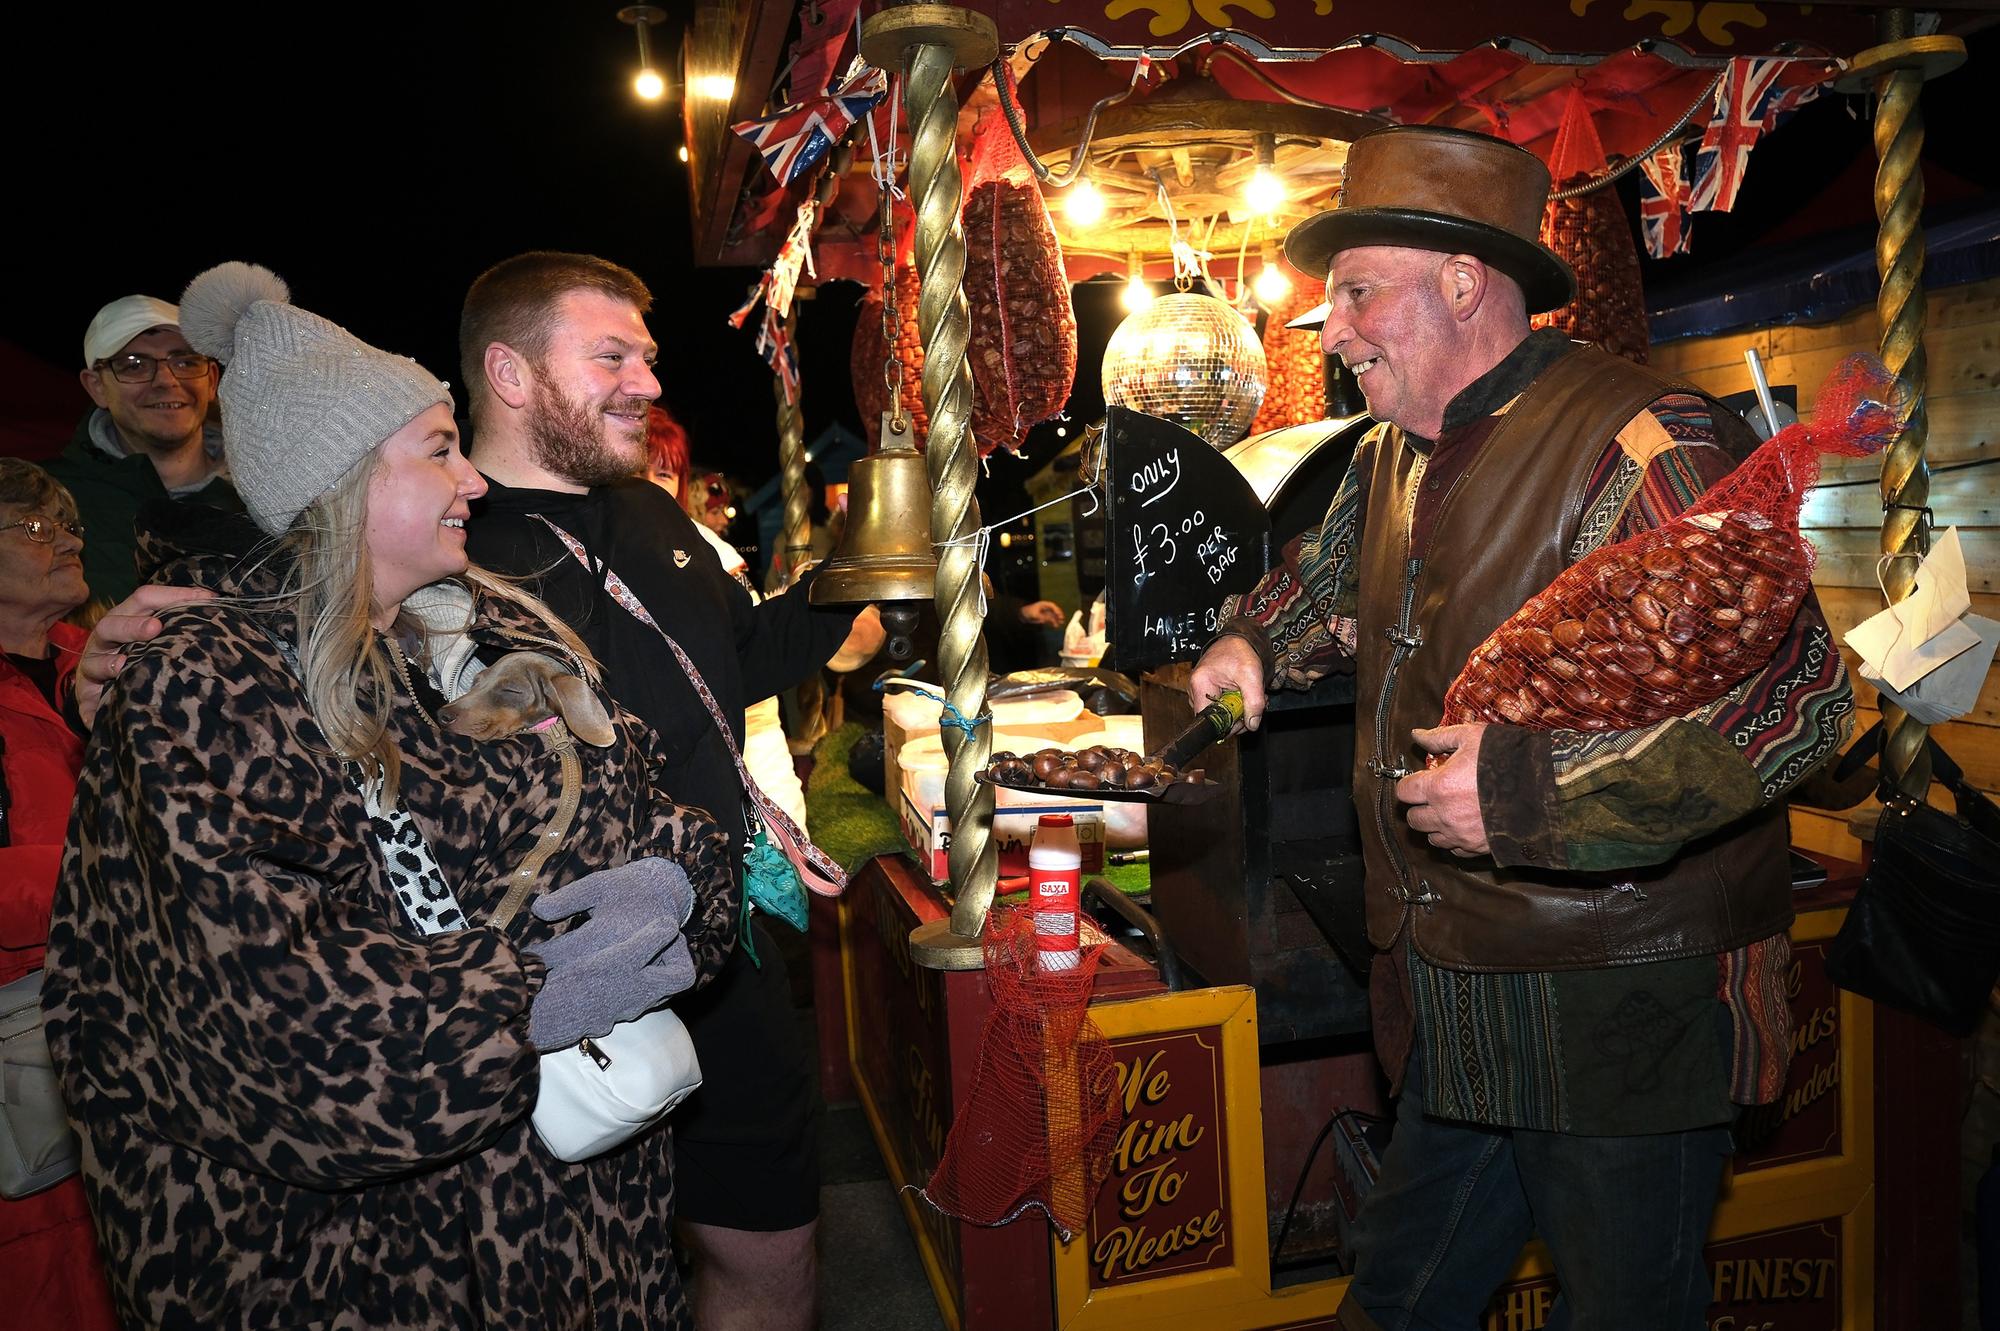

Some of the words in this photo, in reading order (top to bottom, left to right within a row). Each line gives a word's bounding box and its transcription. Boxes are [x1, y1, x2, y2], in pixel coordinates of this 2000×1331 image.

[1132, 448, 1181, 507] ONLY
[1133, 510, 1205, 585] £3.00
[1197, 525, 1228, 565] PER
[1207, 544, 1239, 585] BAG
[1040, 884, 1068, 895] SAXA
[1788, 1006, 1837, 1057] nts
[1093, 1050, 1171, 1114] We
[1774, 1049, 1840, 1124] nded
[1094, 1113, 1204, 1183] Aim
[1122, 1157, 1188, 1216] To
[1093, 1209, 1224, 1279] Please
[1712, 1258, 1838, 1303] FINEST
